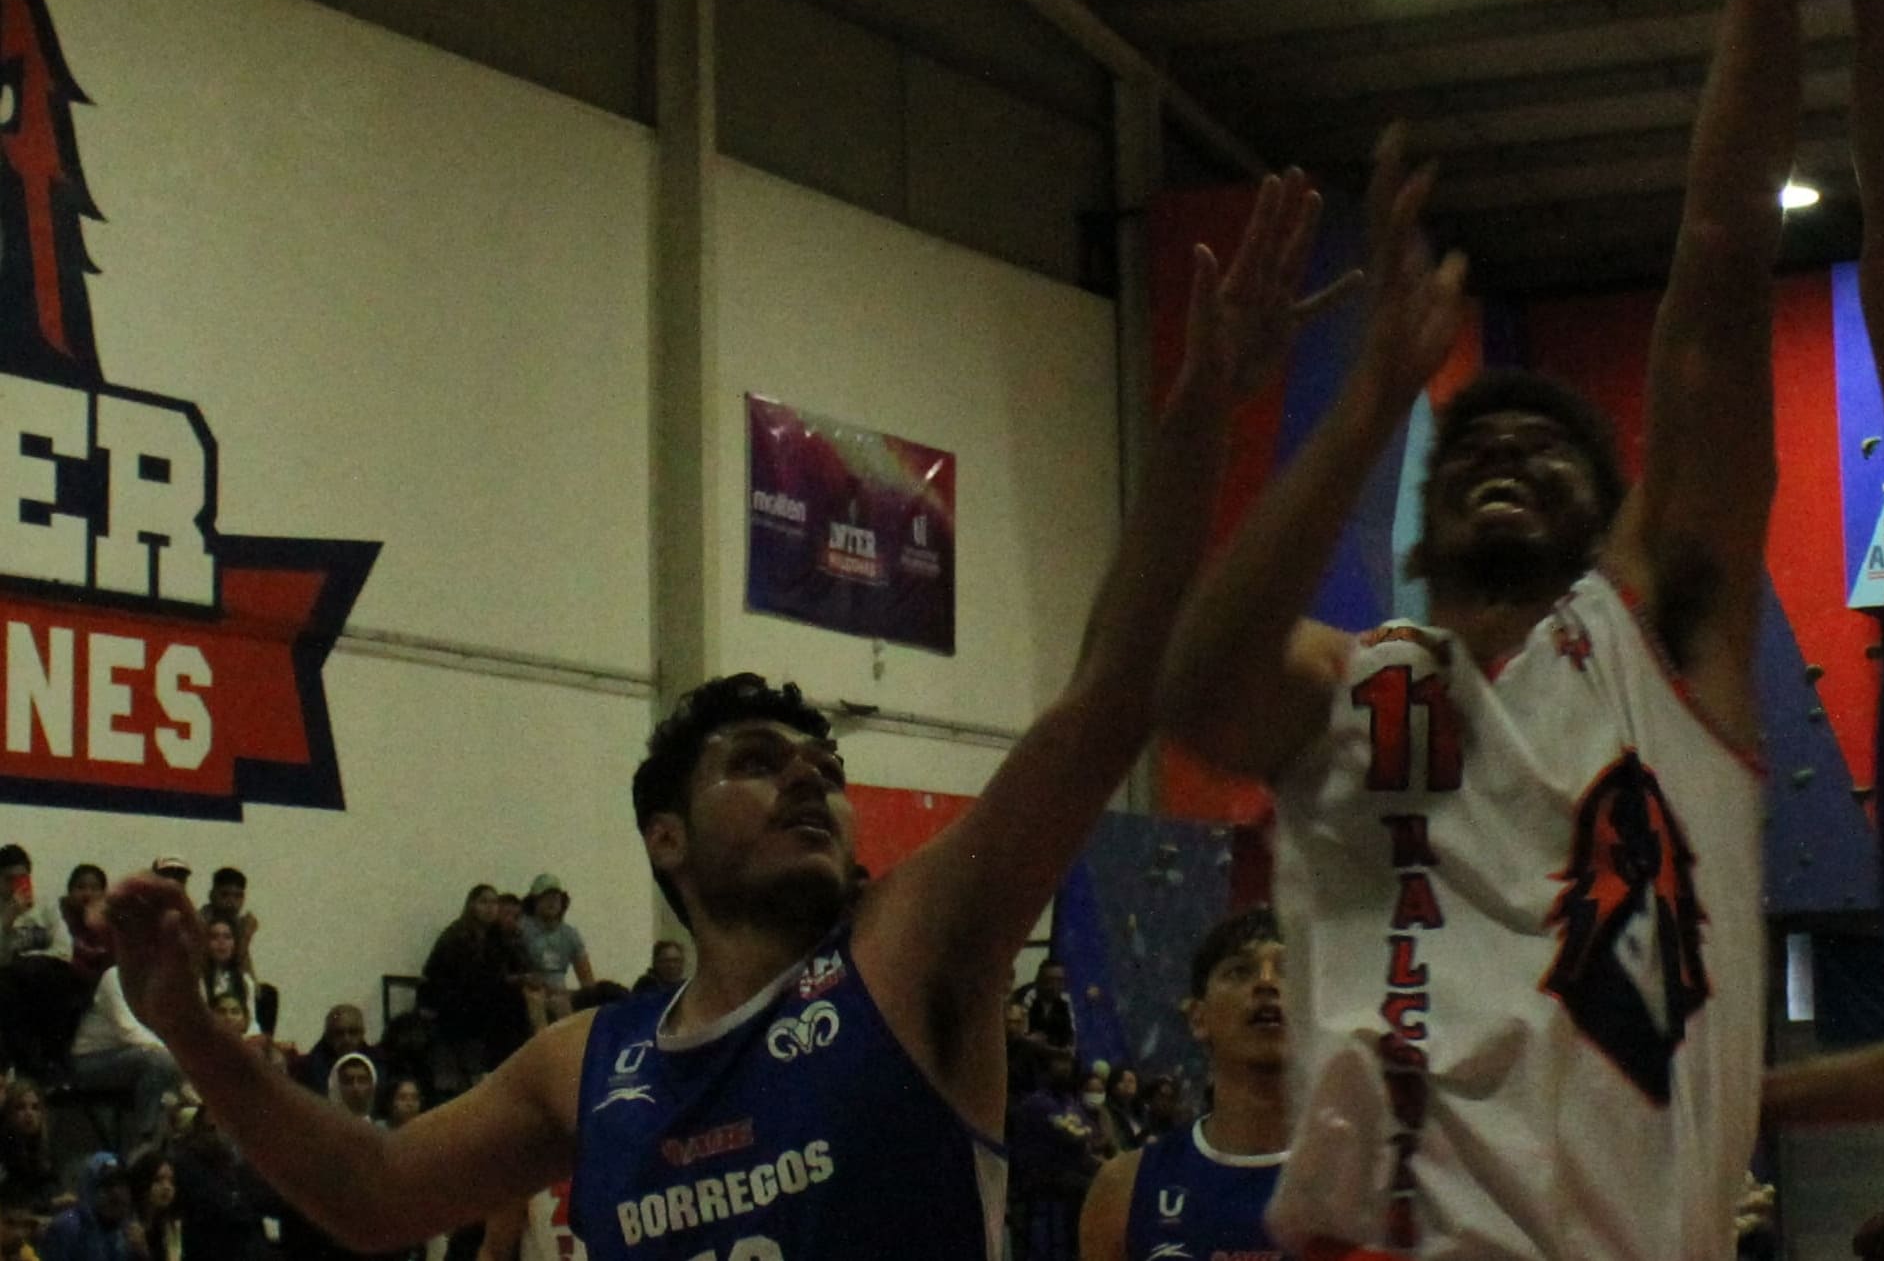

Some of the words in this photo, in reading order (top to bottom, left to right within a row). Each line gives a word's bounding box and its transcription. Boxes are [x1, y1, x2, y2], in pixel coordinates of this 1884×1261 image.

[5, 614, 214, 771] NES
[1352, 664, 1464, 791] 11
[616, 1138, 835, 1248] BORREGOS
